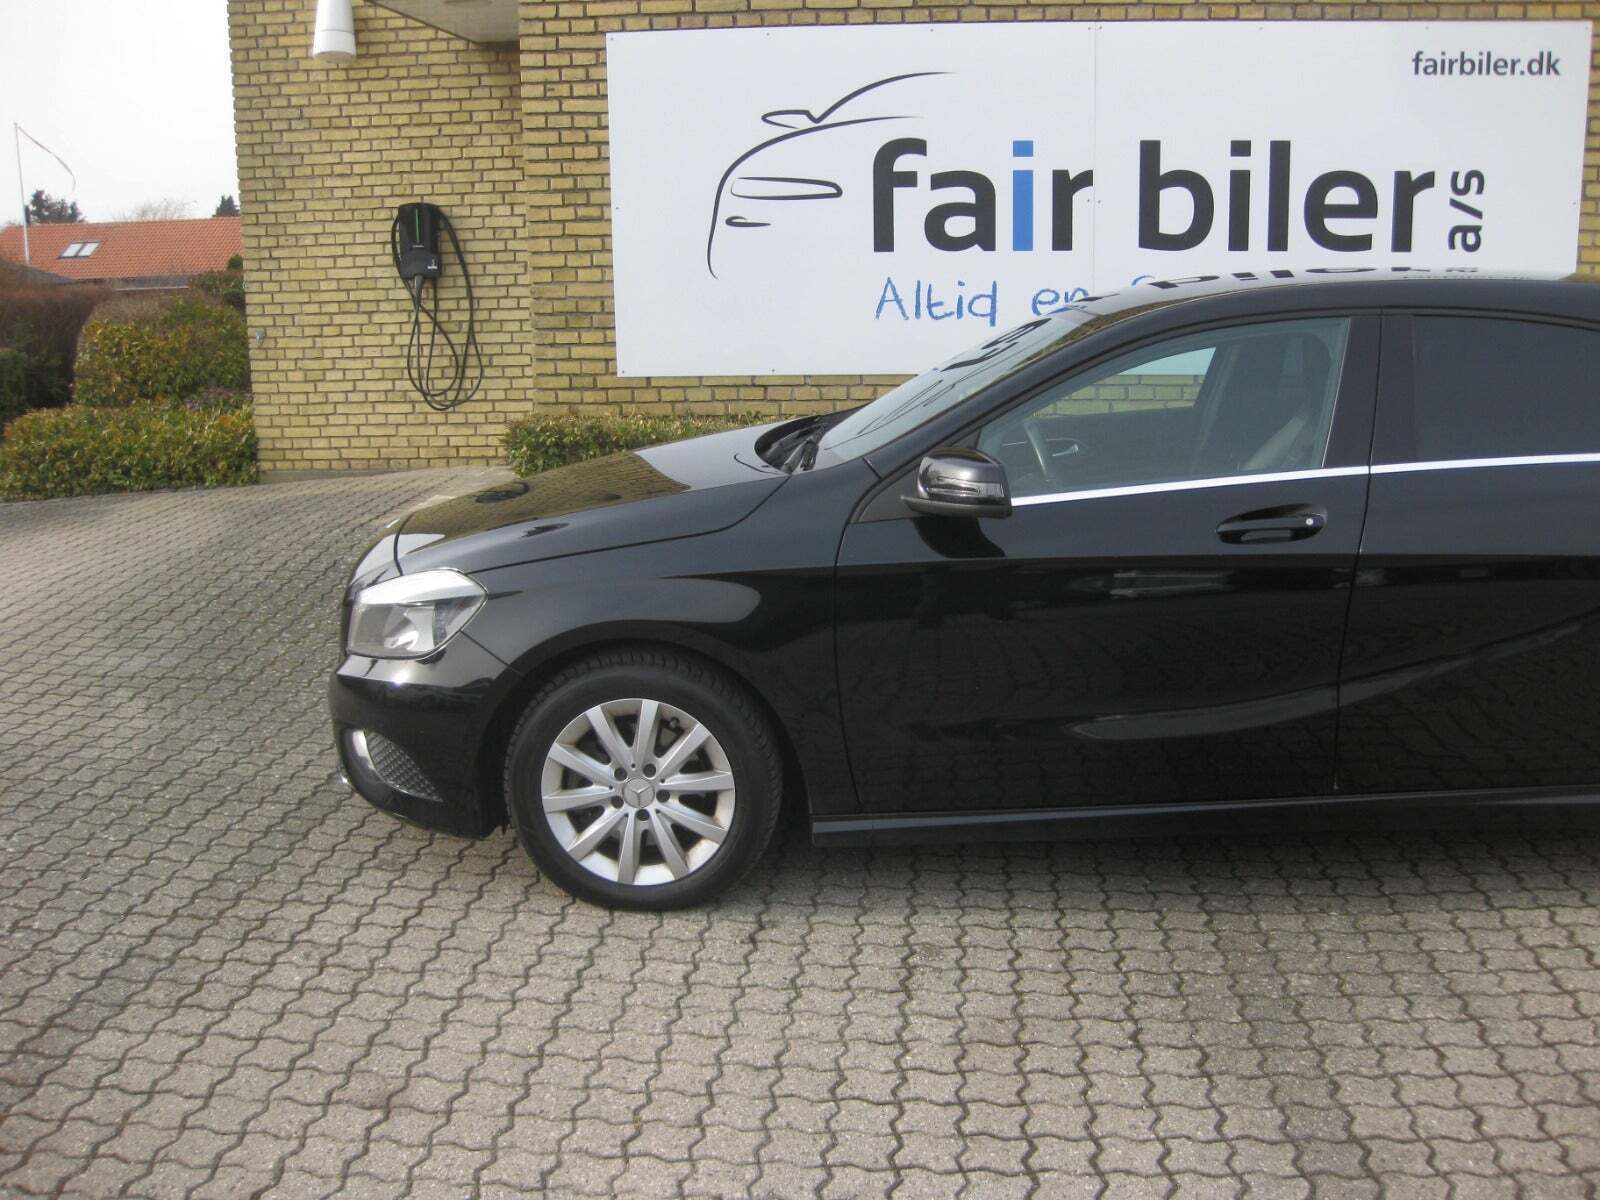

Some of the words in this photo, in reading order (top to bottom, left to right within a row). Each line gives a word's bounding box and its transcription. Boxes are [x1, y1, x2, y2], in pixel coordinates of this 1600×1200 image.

[1412, 50, 1562, 76] fairbiler.dk
[872, 137, 1094, 253] fair
[1138, 139, 1437, 253] biler
[1447, 169, 1486, 253] a/s
[875, 277, 998, 327] Altid
